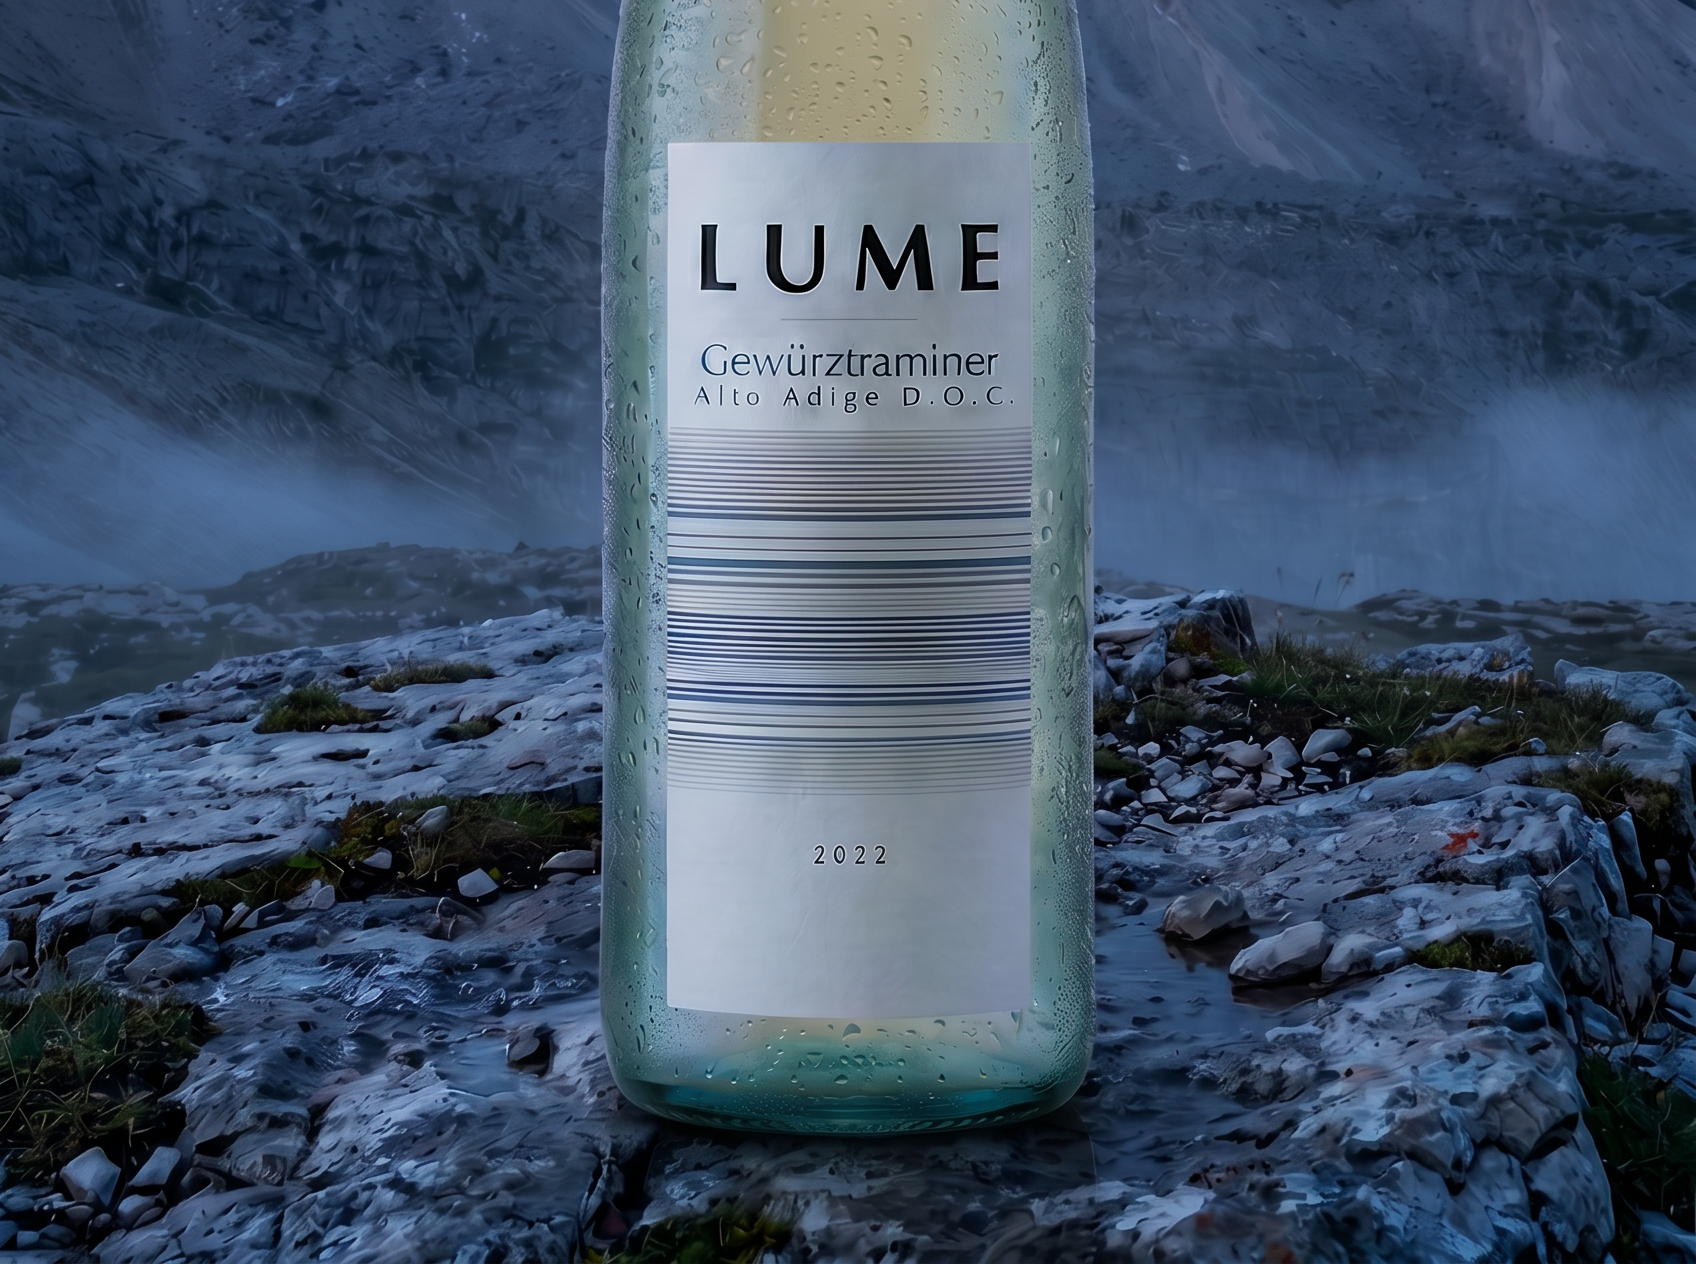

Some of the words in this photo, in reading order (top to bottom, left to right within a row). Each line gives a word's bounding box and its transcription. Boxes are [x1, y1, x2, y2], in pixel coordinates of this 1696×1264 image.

[700, 224, 1000, 293] LUME
[700, 343, 999, 378] Gewürztraminer
[694, 384, 760, 407] Alto
[782, 384, 880, 414] Adige
[902, 385, 1015, 407] D.O.C.
[813, 844, 887, 865] 2022
